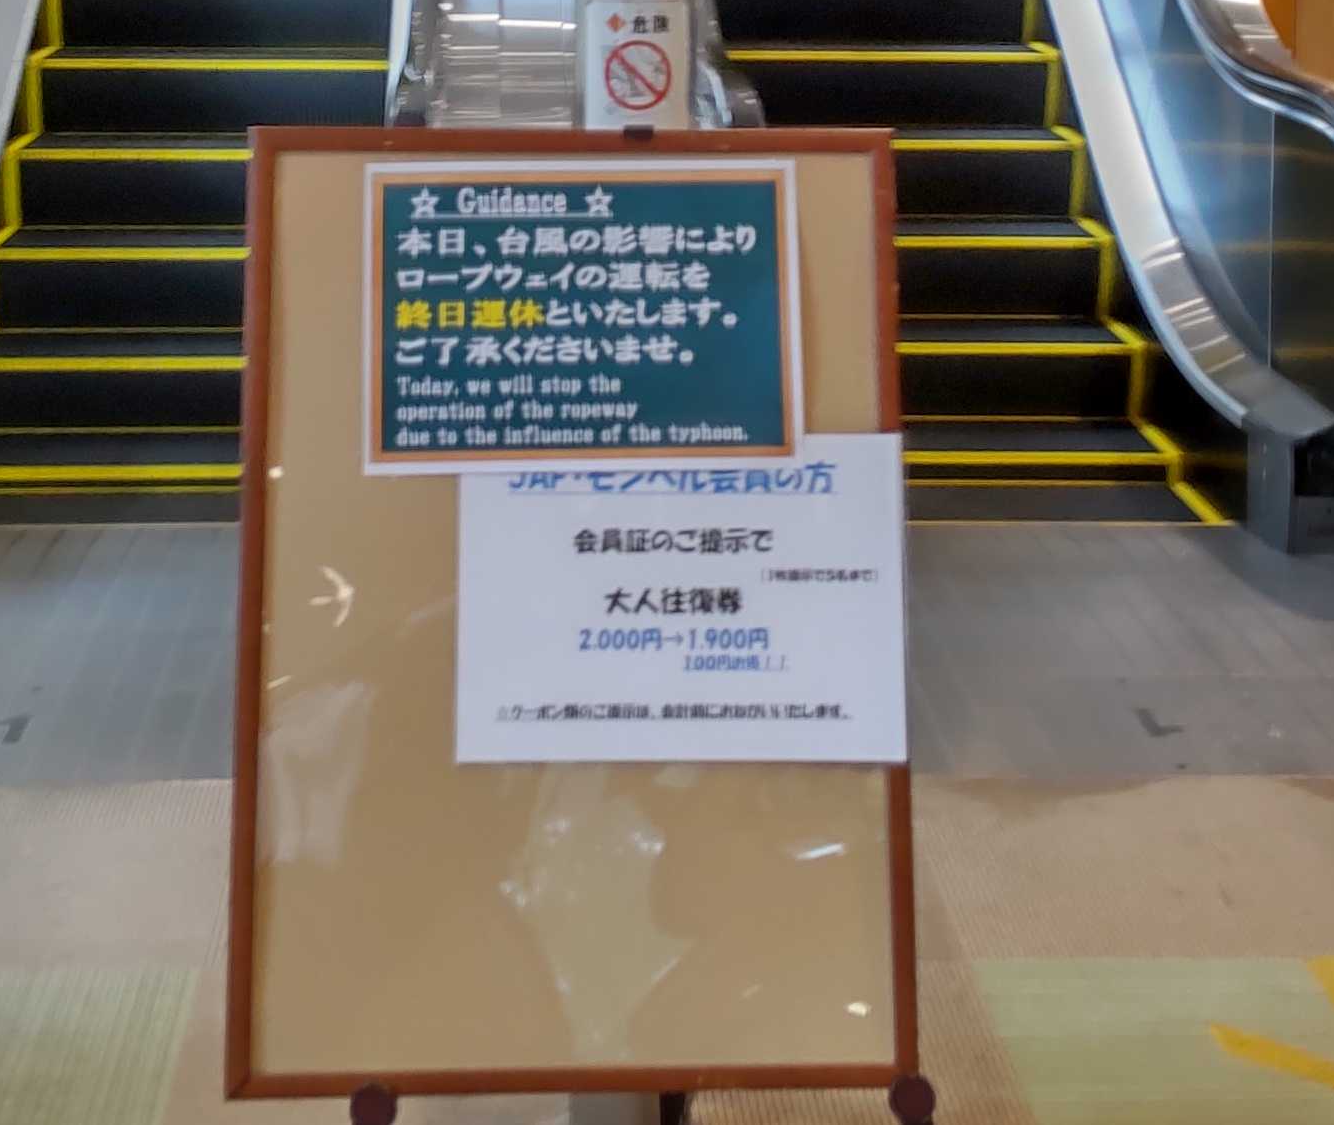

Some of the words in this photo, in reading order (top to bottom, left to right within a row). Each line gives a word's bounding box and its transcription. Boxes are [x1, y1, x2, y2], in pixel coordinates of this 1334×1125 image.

[456, 186, 567, 214] Guidance
[397, 225, 757, 256] 本日、台風の影響により
[396, 261, 711, 291] ロープウェイの運転を
[395, 335, 695, 365] ご了承くださいませ。
[396, 376, 459, 396] Today,
[467, 379, 491, 395] we
[498, 375, 533, 394] will
[541, 376, 581, 396] stop
[589, 374, 621, 394] the
[396, 402, 486, 422] operation
[493, 400, 514, 420] of
[521, 400, 553, 419] the
[561, 402, 638, 420] ropeway
[396, 427, 430, 447] due
[437, 428, 457, 446] to
[466, 426, 497, 445] the
[504, 425, 594, 445] influence
[601, 424, 622, 444] of
[628, 424, 661, 443] the
[668, 422, 748, 443] typhoon.
[573, 528, 774, 554] 会員証のご提示で
[604, 587, 742, 614] 大人往復券
